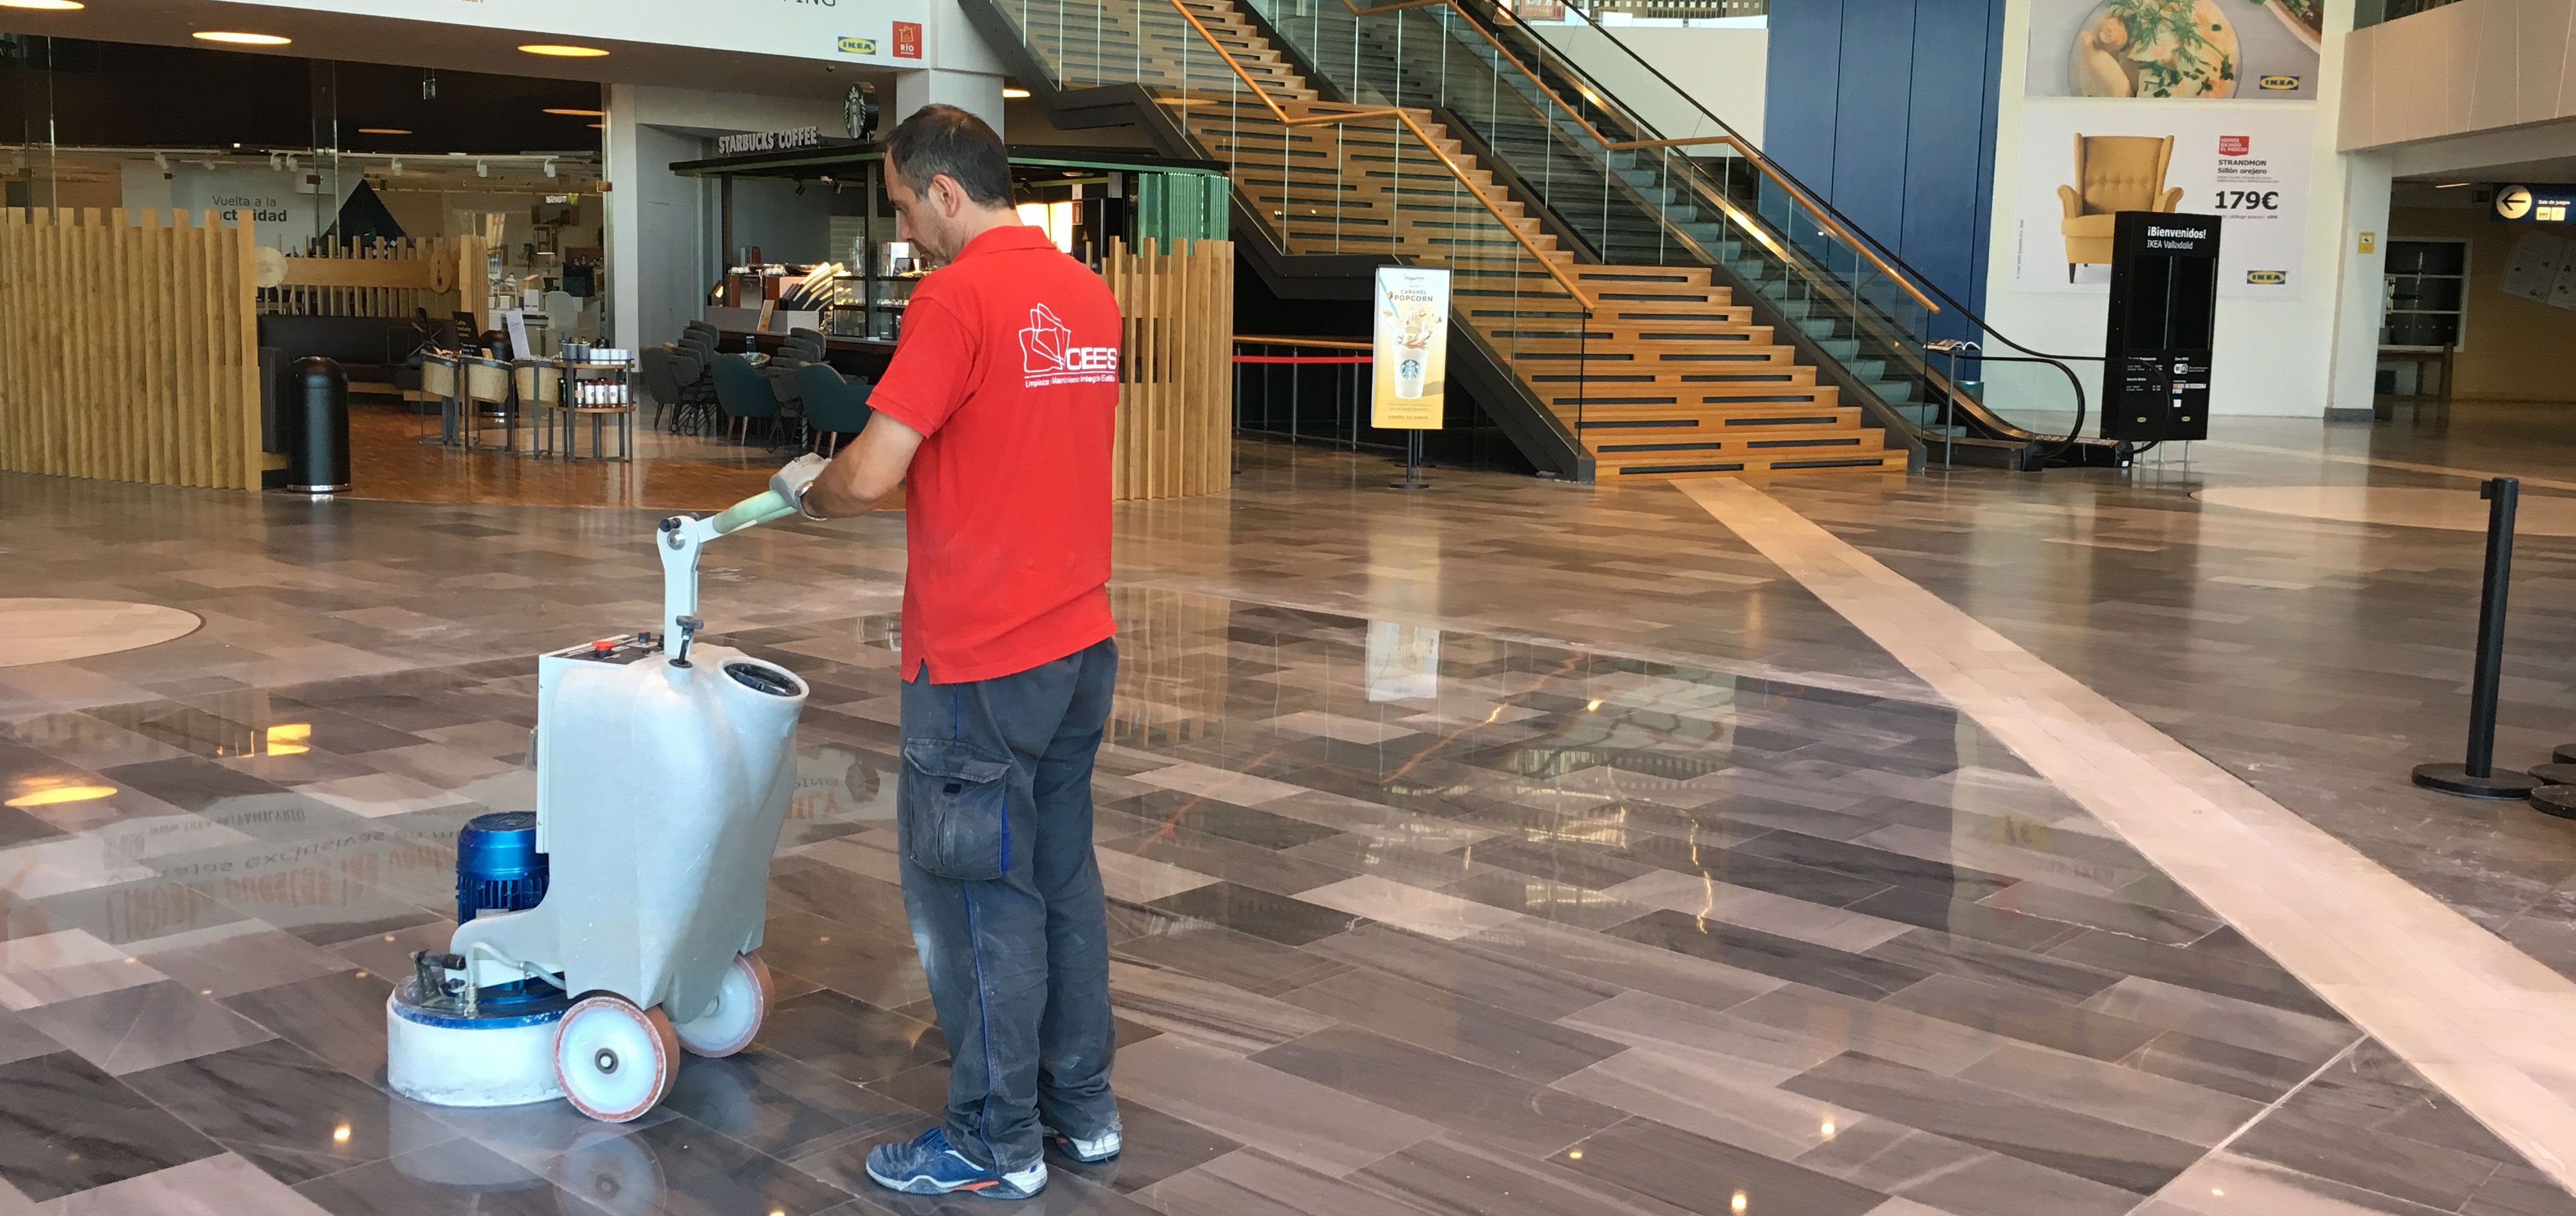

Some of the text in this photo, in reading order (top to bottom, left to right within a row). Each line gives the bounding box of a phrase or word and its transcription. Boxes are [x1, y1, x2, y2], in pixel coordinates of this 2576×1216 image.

[900, 43, 914, 51] RÍO
[719, 126, 817, 154] STARBUCKS COFFEE
[212, 195, 250, 206] Vuelta
[266, 197, 277, 207] la
[2215, 191, 2279, 210] 179€
[2147, 226, 2206, 239] ¡Bienvenidos!
[2147, 239, 2193, 249] IKEA Valladolid
[1066, 347, 1117, 370] CEES
